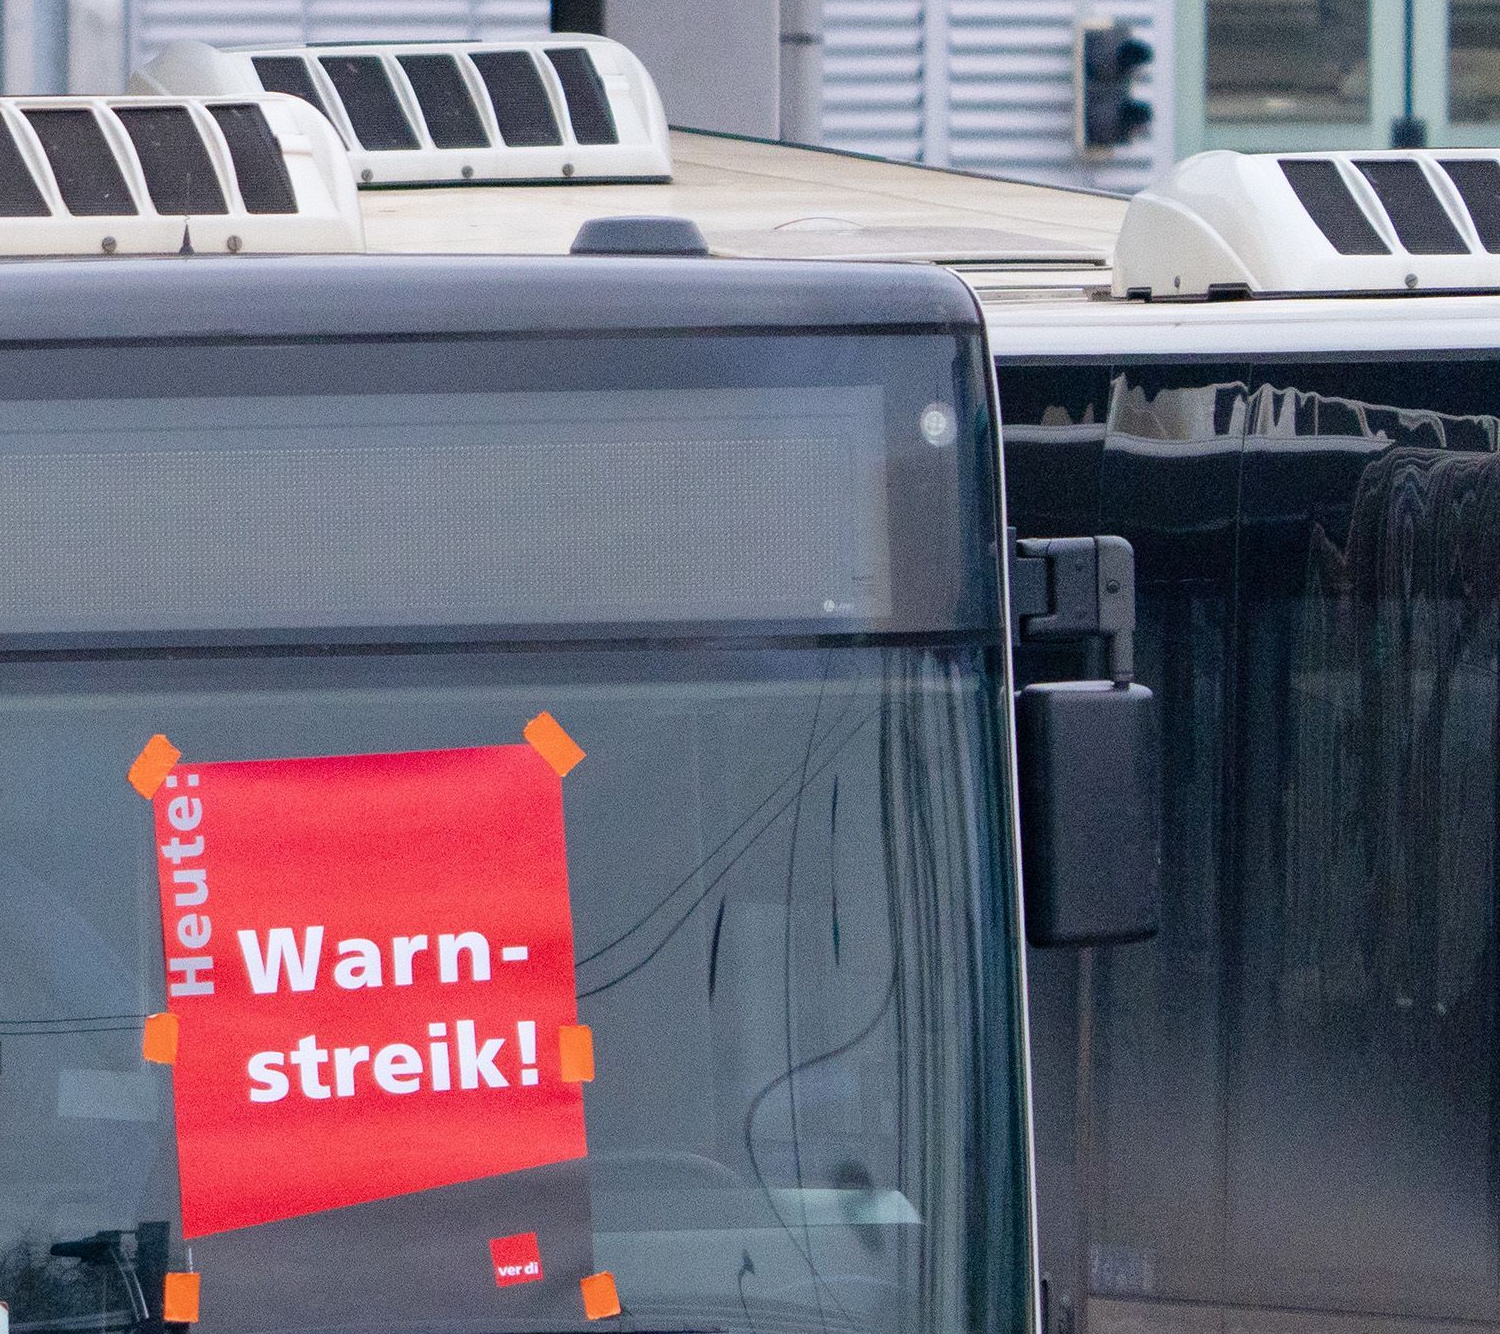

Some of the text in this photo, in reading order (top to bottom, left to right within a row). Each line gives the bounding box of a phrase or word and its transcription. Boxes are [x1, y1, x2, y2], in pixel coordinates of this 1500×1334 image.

[162, 773, 215, 997] Heute:
[237, 925, 529, 995] Warn-
[248, 1020, 540, 1103] streik!
